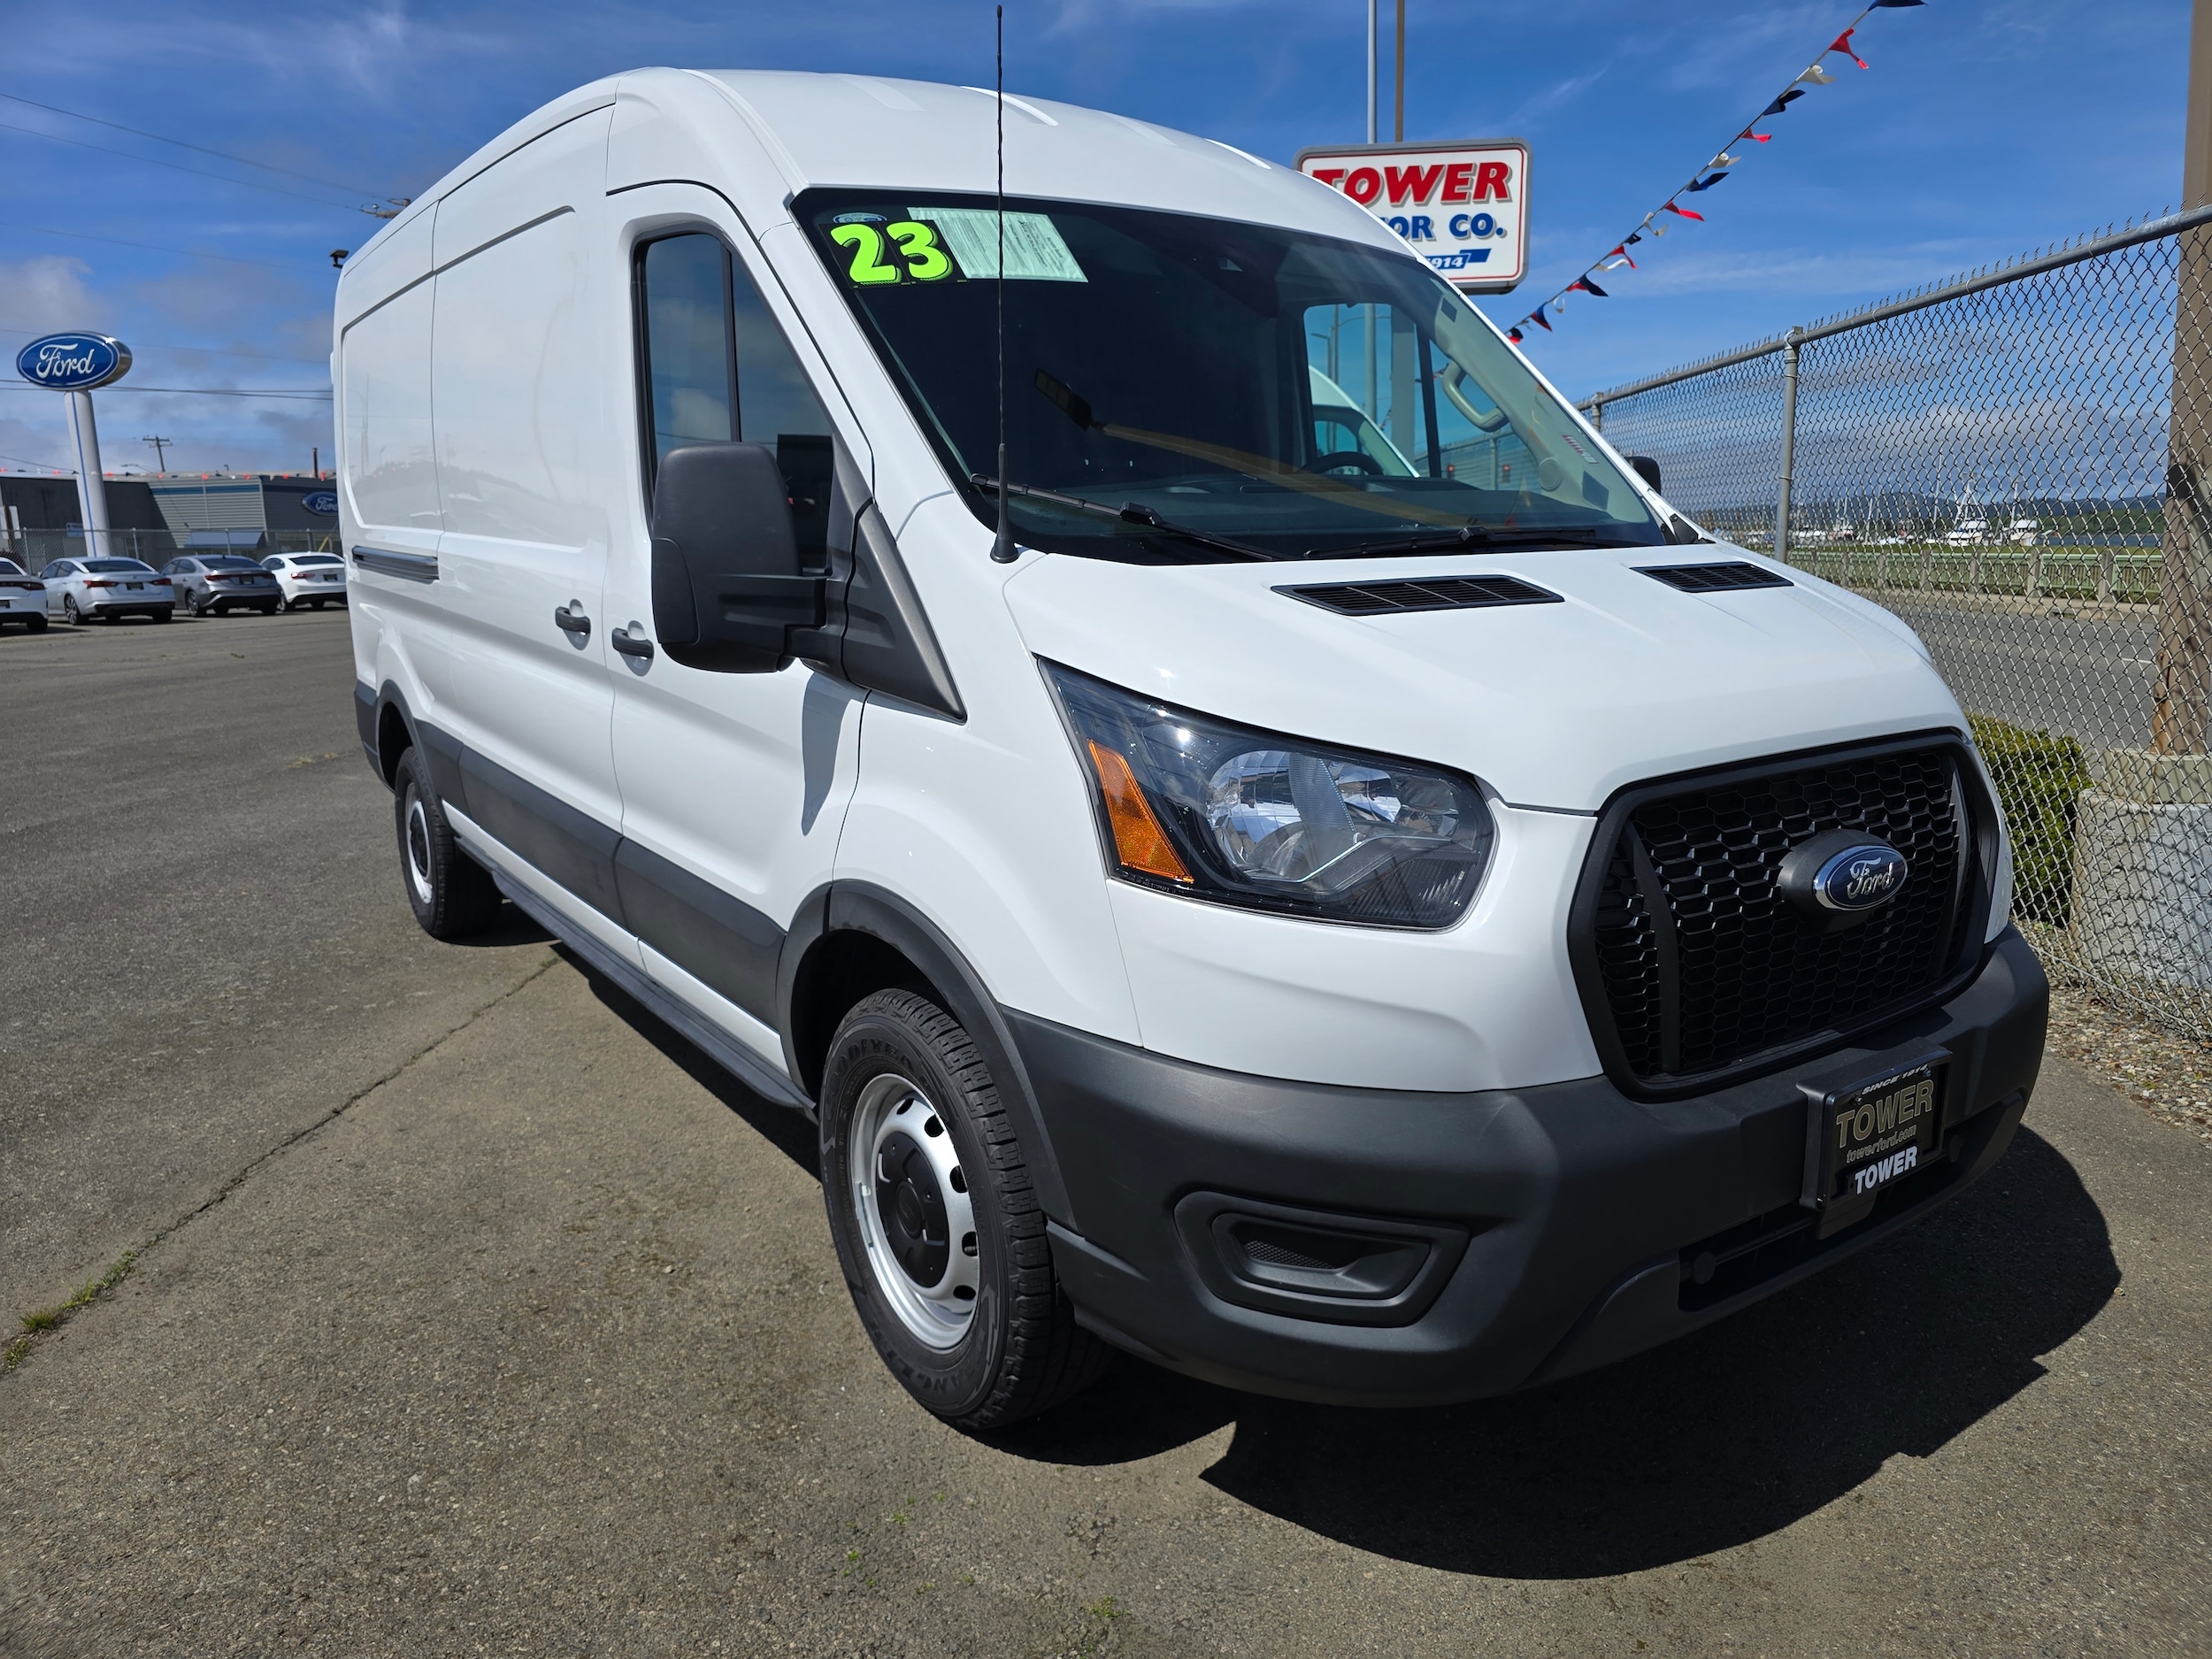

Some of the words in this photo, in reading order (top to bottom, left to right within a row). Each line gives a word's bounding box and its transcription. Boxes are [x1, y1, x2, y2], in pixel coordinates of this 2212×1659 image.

[1312, 162, 1510, 204] TOWER
[1448, 212, 1504, 237] CO.
[830, 222, 953, 284] 23
[1427, 257, 1463, 268] 914
[35, 342, 96, 378] Ford
[1847, 856, 1894, 900] Ford
[1861, 1076, 1900, 1095] SINCE
[1835, 1079, 1935, 1149] TOWER
[1846, 1124, 1918, 1164] towerford.com
[1854, 1145, 1918, 1195] TOWER
